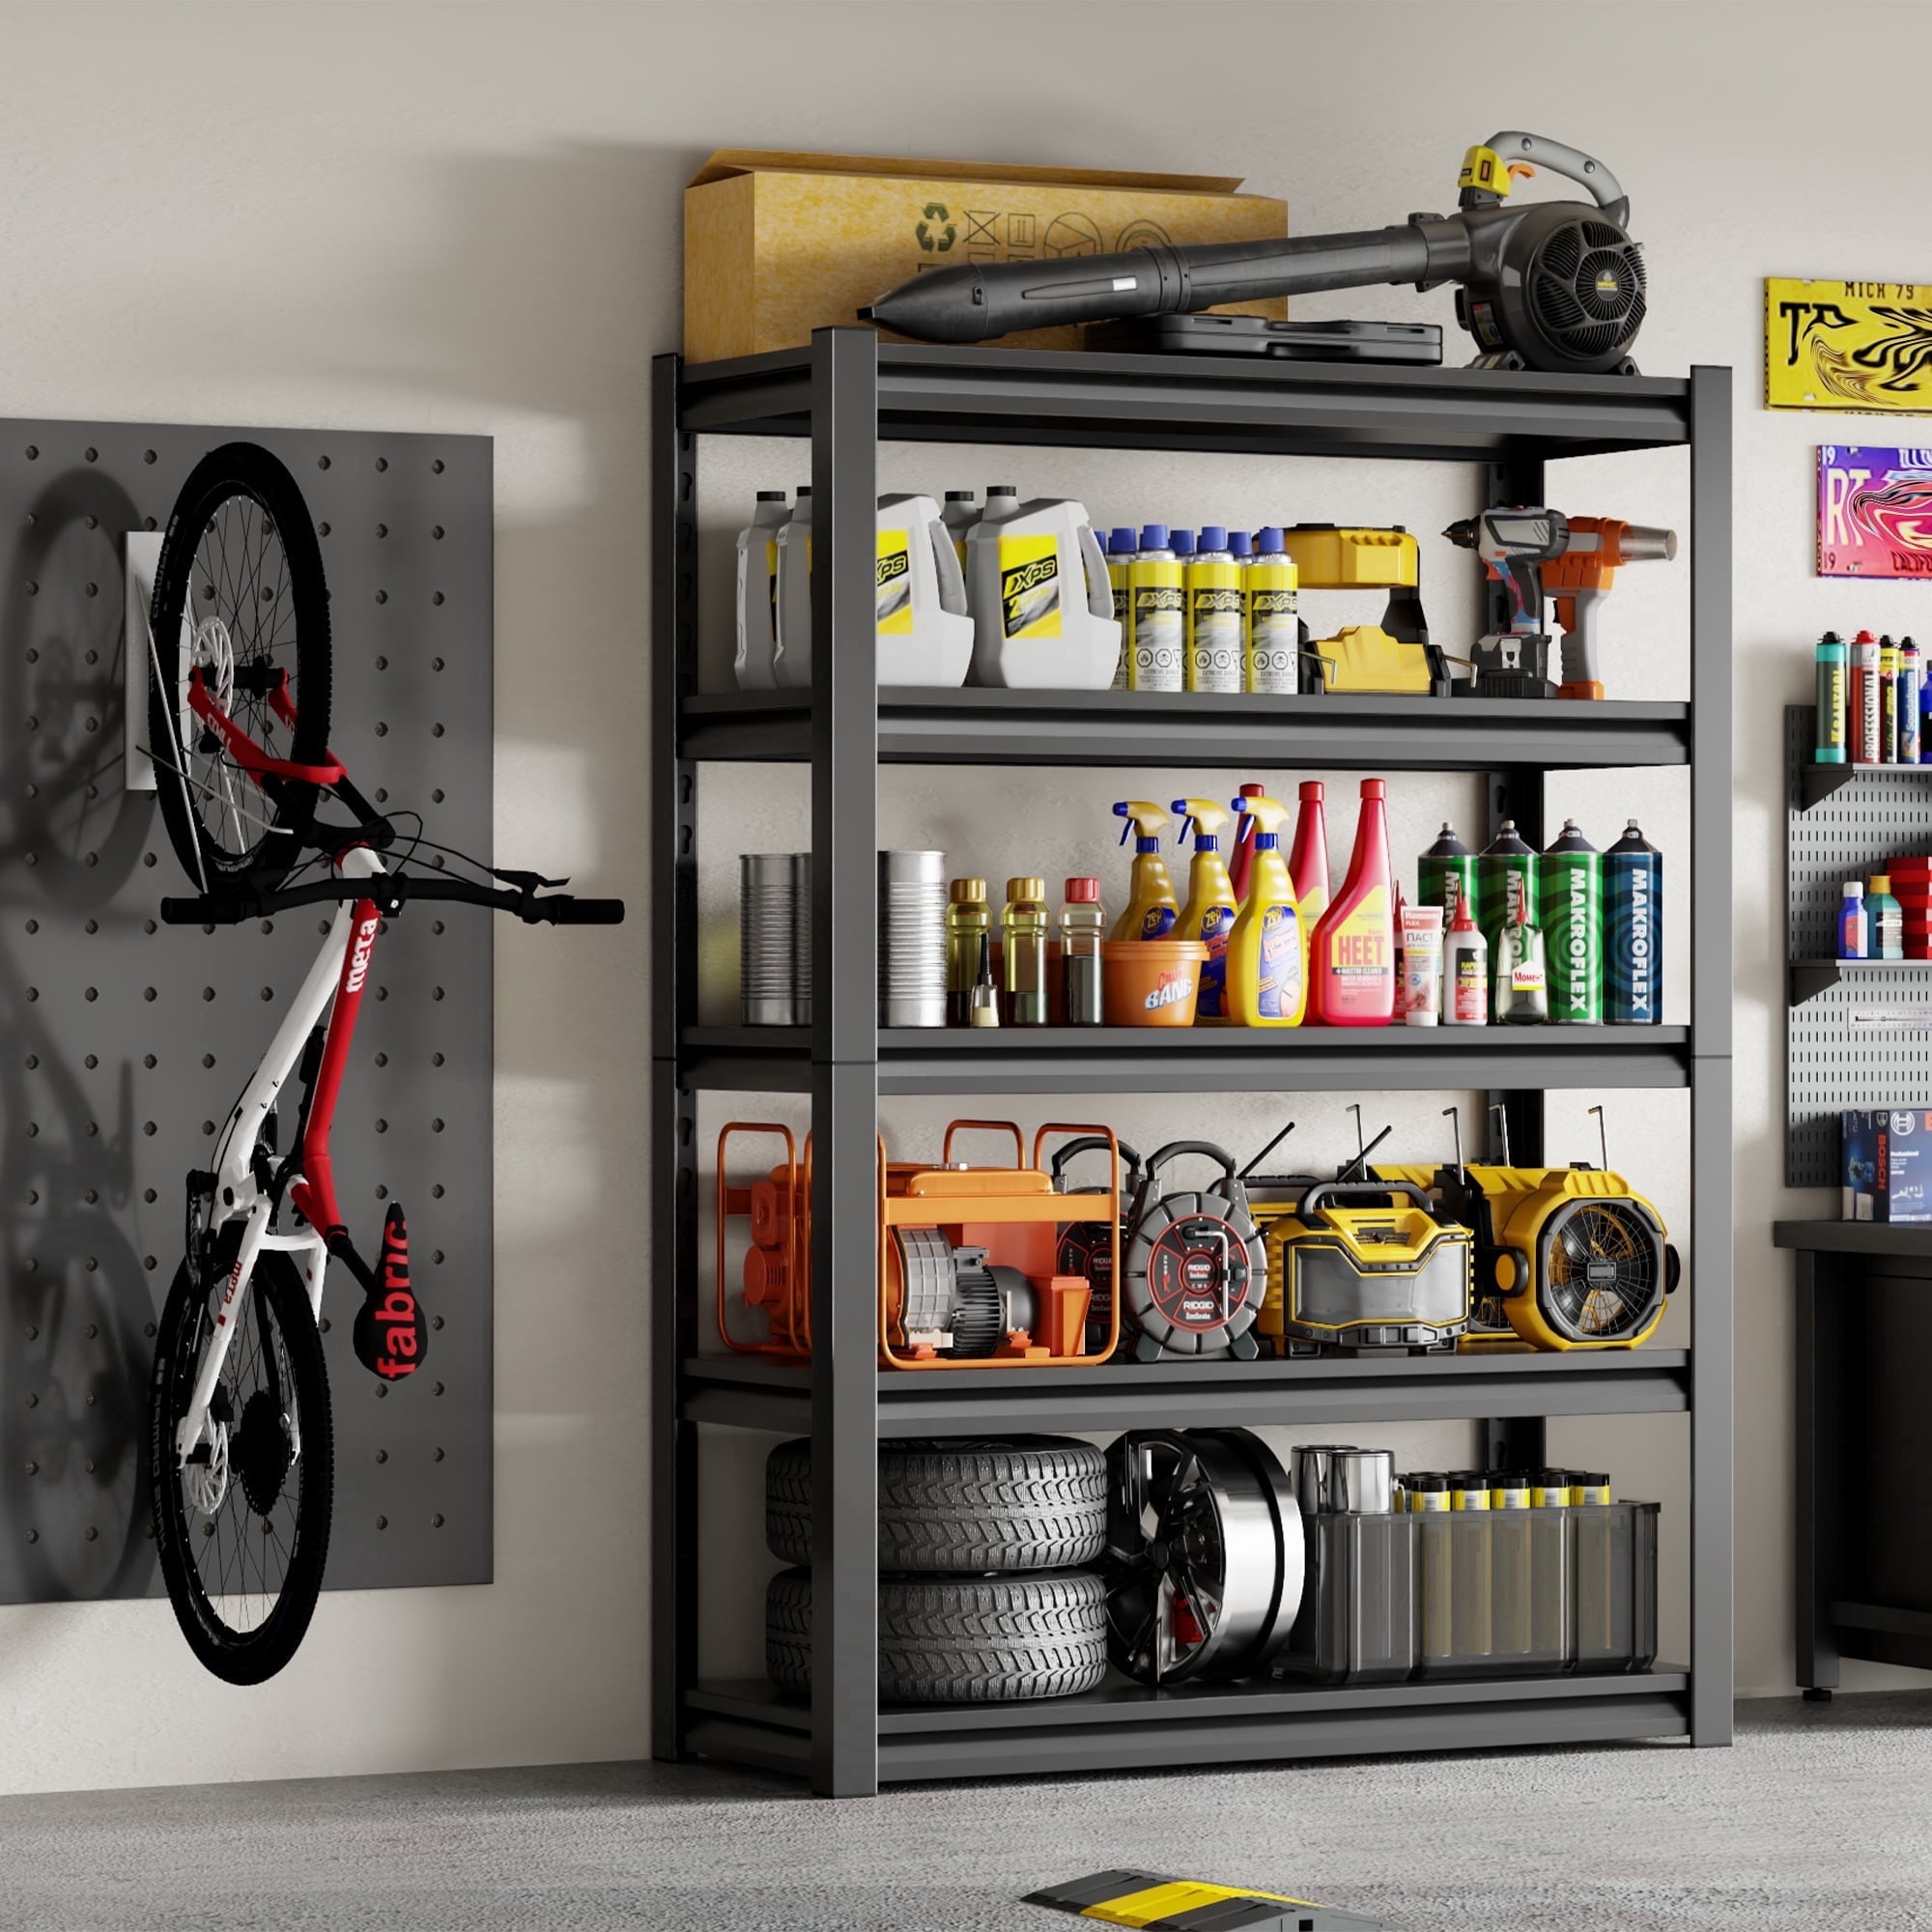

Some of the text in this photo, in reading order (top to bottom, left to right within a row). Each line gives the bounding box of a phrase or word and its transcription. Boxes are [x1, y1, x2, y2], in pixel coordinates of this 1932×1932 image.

[1844, 281, 1915, 300] MICH 79
[1821, 445, 1835, 467] 19
[1823, 552, 1836, 571] 19
[1009, 595, 1021, 619] 2
[1338, 935, 1384, 966] HEET
[1570, 867, 1586, 1011] MAKROFLEX
[1632, 868, 1647, 1011] MAKROFLEX
[1145, 978, 1193, 1010] BANG
[1878, 1133, 1887, 1190] BOSCH
